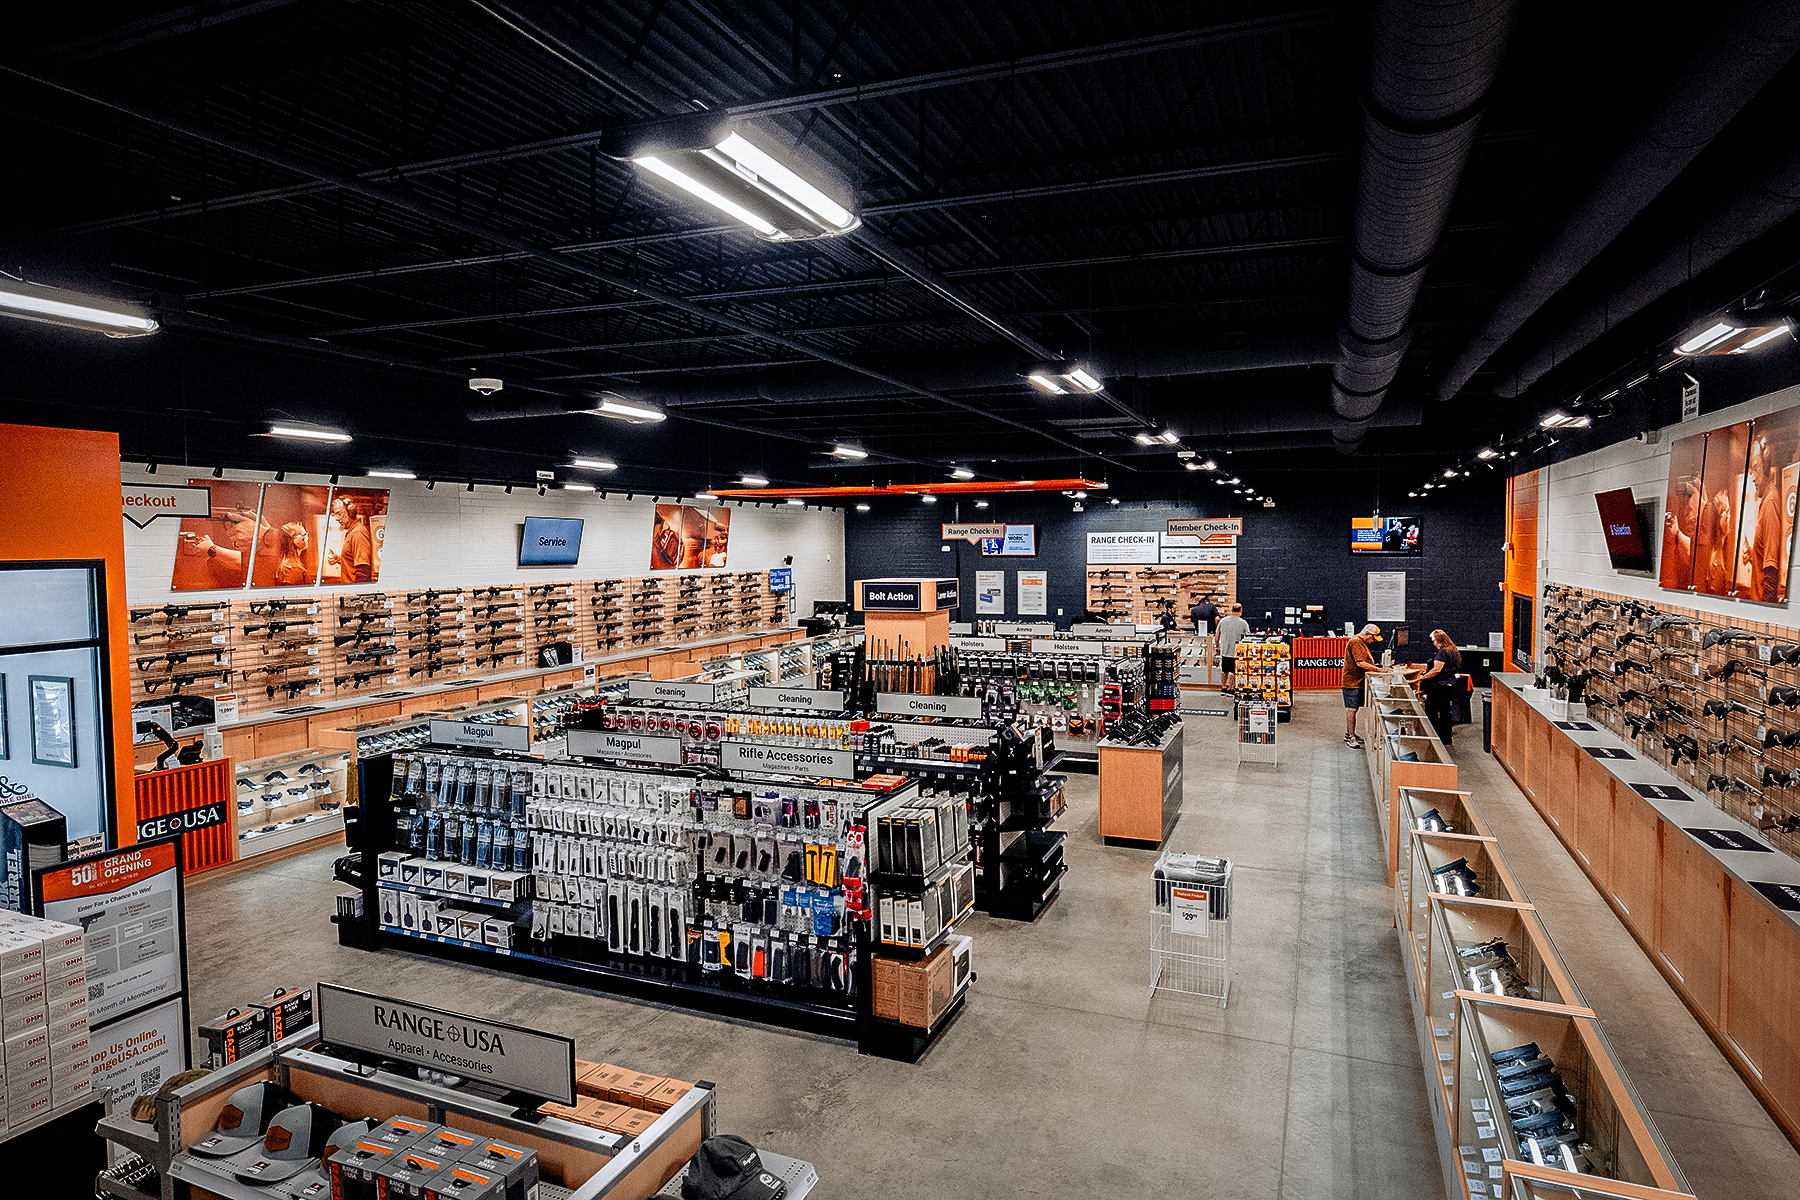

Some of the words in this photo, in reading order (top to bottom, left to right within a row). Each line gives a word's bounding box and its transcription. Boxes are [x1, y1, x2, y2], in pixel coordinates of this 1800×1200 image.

[947, 528, 968, 536] Range
[969, 527, 1000, 535] Check-In
[1169, 523, 1202, 532] Member
[1203, 523, 1239, 531] Check-In
[538, 536, 567, 548] Service
[1091, 536, 1116, 544] RANGE
[1118, 536, 1155, 544] CHECK-IN
[869, 591, 886, 600] Bolt
[887, 591, 914, 601] Action
[655, 687, 686, 698] Cleaning
[778, 694, 812, 706] Cleaning
[909, 701, 947, 712] Cleaning
[463, 725, 493, 738] Magpul
[454, 737, 476, 745] Magazines
[606, 737, 641, 750] Magpul
[597, 749, 621, 758] Magazines
[624, 751, 652, 759] Accessories
[739, 747, 764, 760] Rifle
[766, 749, 834, 765] Accessories
[762, 763, 790, 772] Magazines
[184, 808, 219, 828] USA
[104, 851, 142, 868] GRAND
[104, 858, 152, 878] OPENING
[71, 865, 92, 887] 50
[77, 903, 93, 913] Enter
[110, 893, 131, 903] Chance
[139, 885, 153, 895] Win!
[65, 936, 82, 945] 9MM
[23, 950, 42, 959] 9MM
[65, 957, 83, 966] 9MM
[24, 972, 42, 981] 9MM
[68, 977, 85, 986] 9MM
[25, 992, 42, 1002] 9MM
[69, 998, 86, 1007] 9MM
[96, 1002, 118, 1016] Month
[119, 997, 126, 1006] of
[127, 982, 168, 1002] Membership!
[26, 1013, 44, 1023] 9MM
[70, 1019, 87, 1029] 9MM
[274, 1006, 283, 1042] RAZO
[373, 1005, 445, 1041] RANGE
[463, 1026, 506, 1056] USA
[27, 1034, 45, 1045] 9MM
[71, 1040, 88, 1050] 9MM
[110, 1043, 123, 1055] Us
[125, 1029, 158, 1048] Online
[226, 1027, 236, 1065] RAZO
[92, 1035, 166, 1075] angeUSA.com!
[388, 1038, 424, 1056] Apparel
[432, 1049, 493, 1074] Accessories
[29, 1056, 47, 1067] 9MM
[72, 1059, 89, 1070] 9MM
[106, 1067, 127, 1080] Ammo
[134, 1048, 169, 1068] Accessories
[30, 1077, 48, 1088] 9MM
[73, 1080, 90, 1091] 9MM
[121, 1079, 135, 1091] and
[30, 1098, 48, 1109] 9MM
